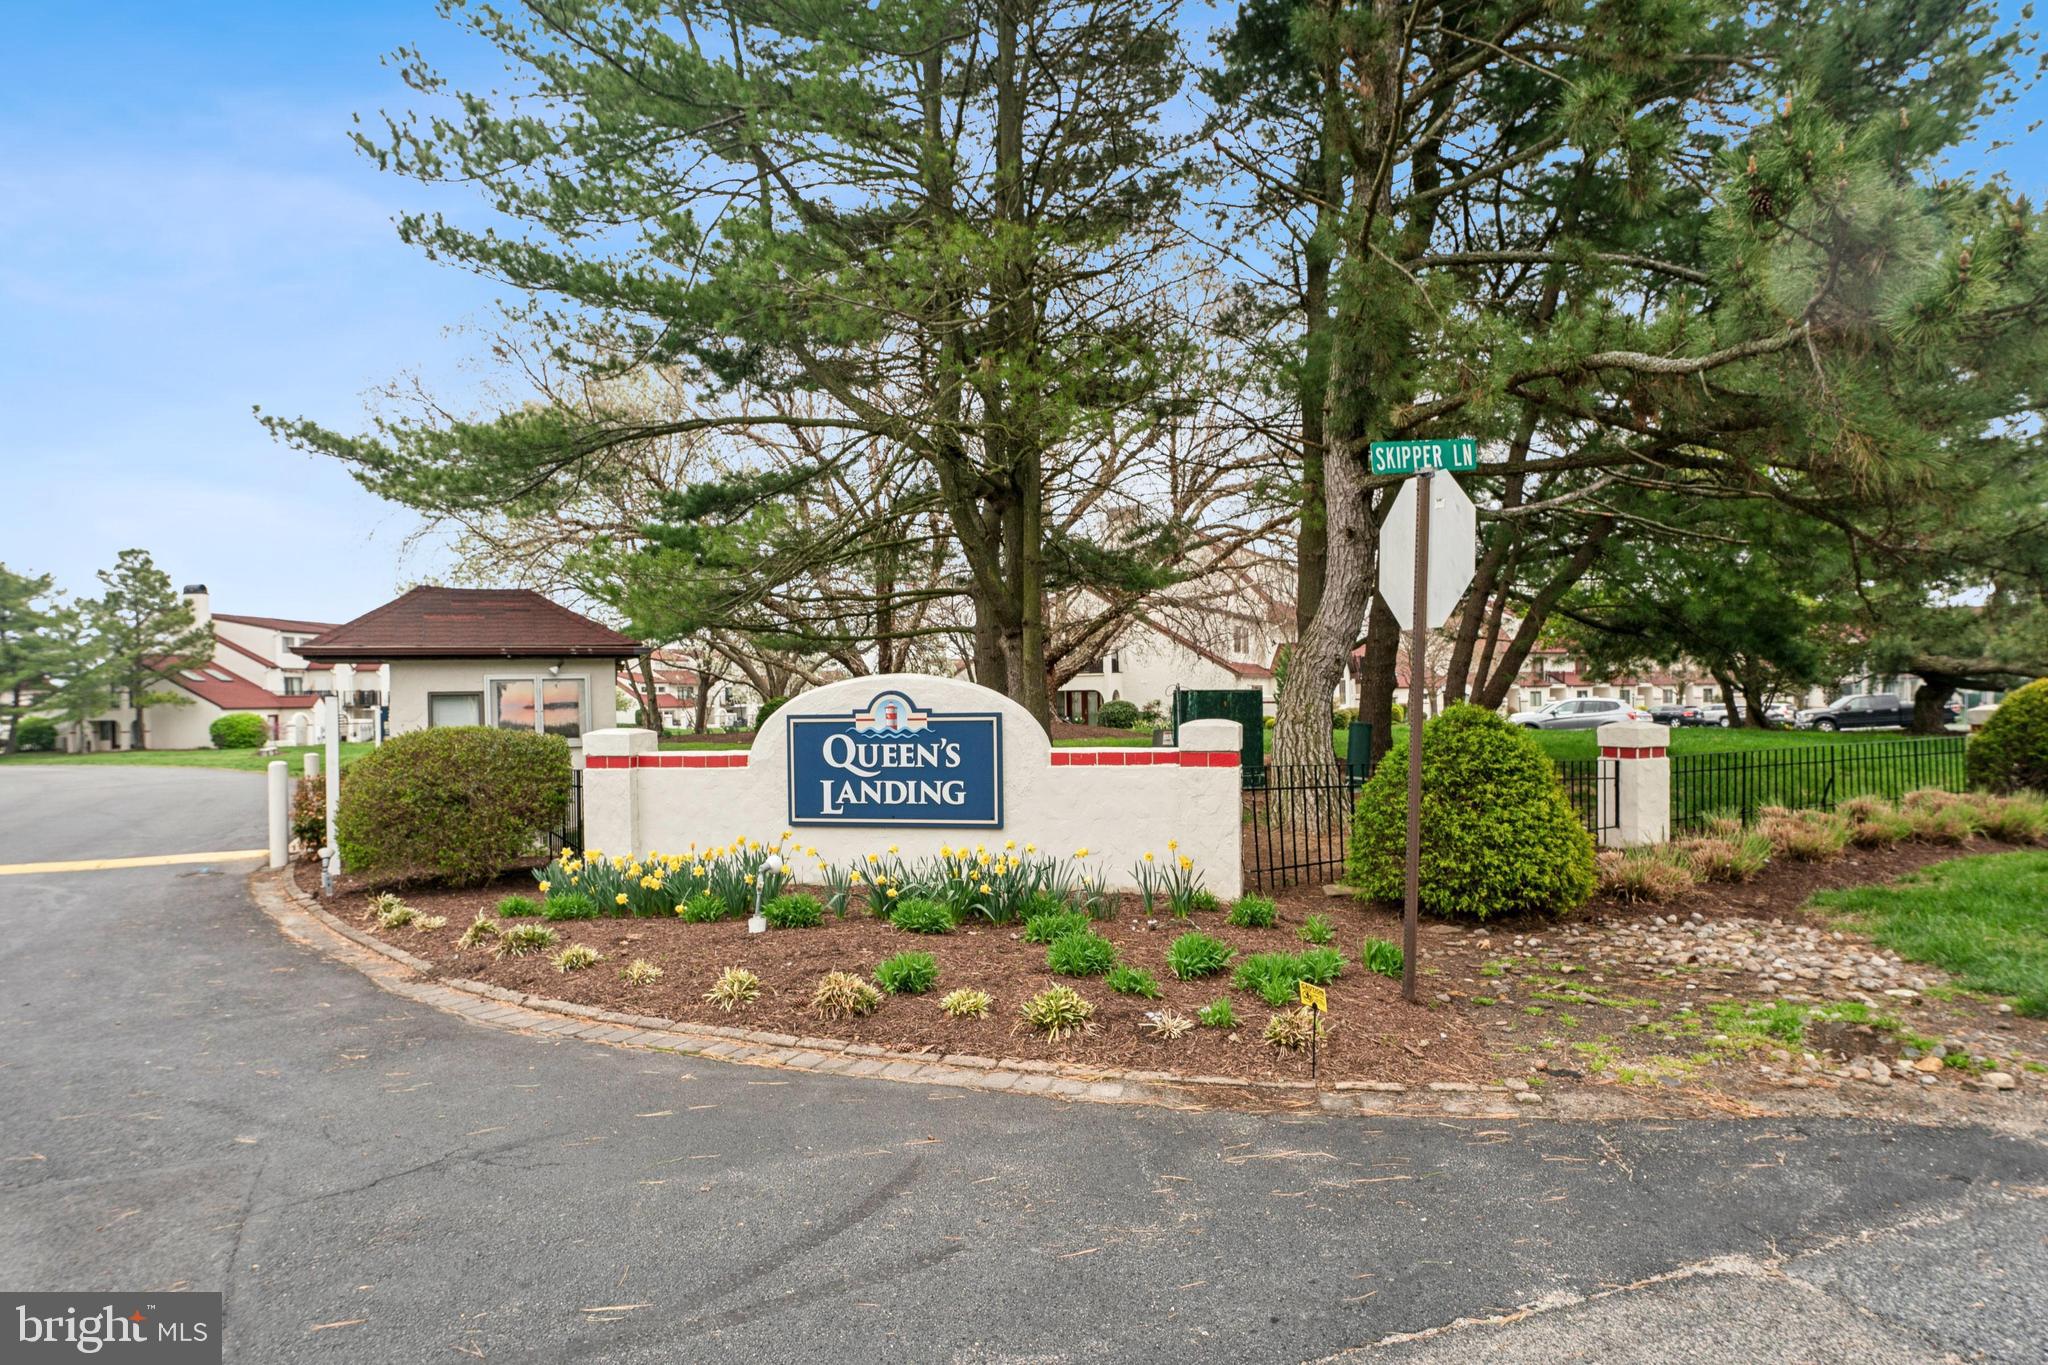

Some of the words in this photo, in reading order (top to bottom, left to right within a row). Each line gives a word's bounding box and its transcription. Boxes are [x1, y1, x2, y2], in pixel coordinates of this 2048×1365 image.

[1375, 444, 1443, 471] SKIPPER
[1453, 443, 1473, 467] LN
[822, 733, 961, 778] QUEEN'S
[819, 779, 967, 815] LANDING
